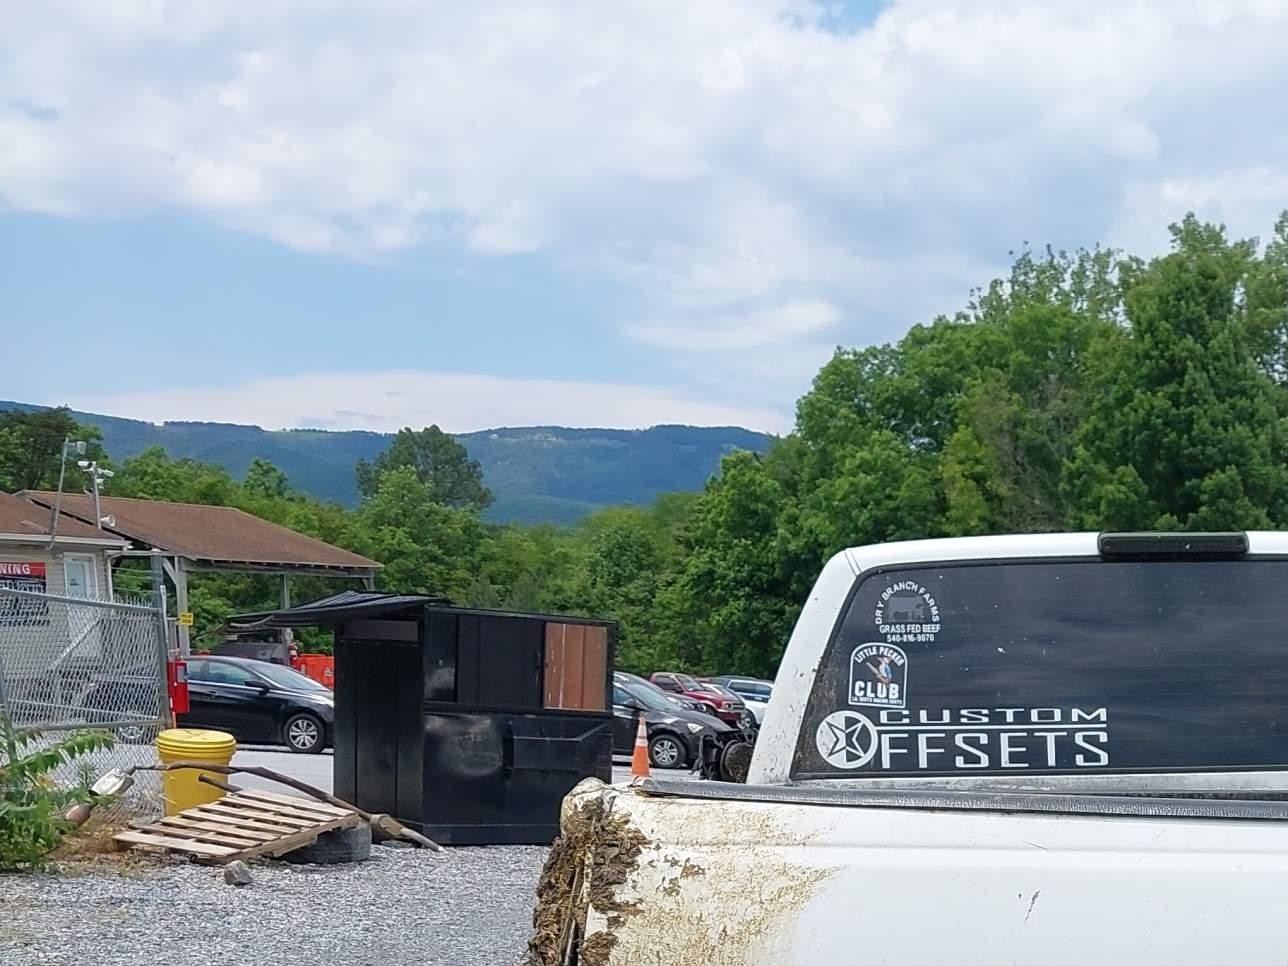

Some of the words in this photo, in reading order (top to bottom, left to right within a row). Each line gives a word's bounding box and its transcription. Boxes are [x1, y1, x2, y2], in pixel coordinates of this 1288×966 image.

[875, 600, 884, 625] DRY
[881, 581, 919, 601] BRANCH
[918, 587, 940, 622] FARMS
[879, 624, 905, 634] GRASS
[907, 624, 921, 633] FED
[922, 624, 941, 633] BEEF
[854, 646, 878, 664] LITTLE
[879, 646, 905, 666] PECKER
[854, 680, 900, 699] CLUB
[880, 707, 1108, 724] CUSTOM
